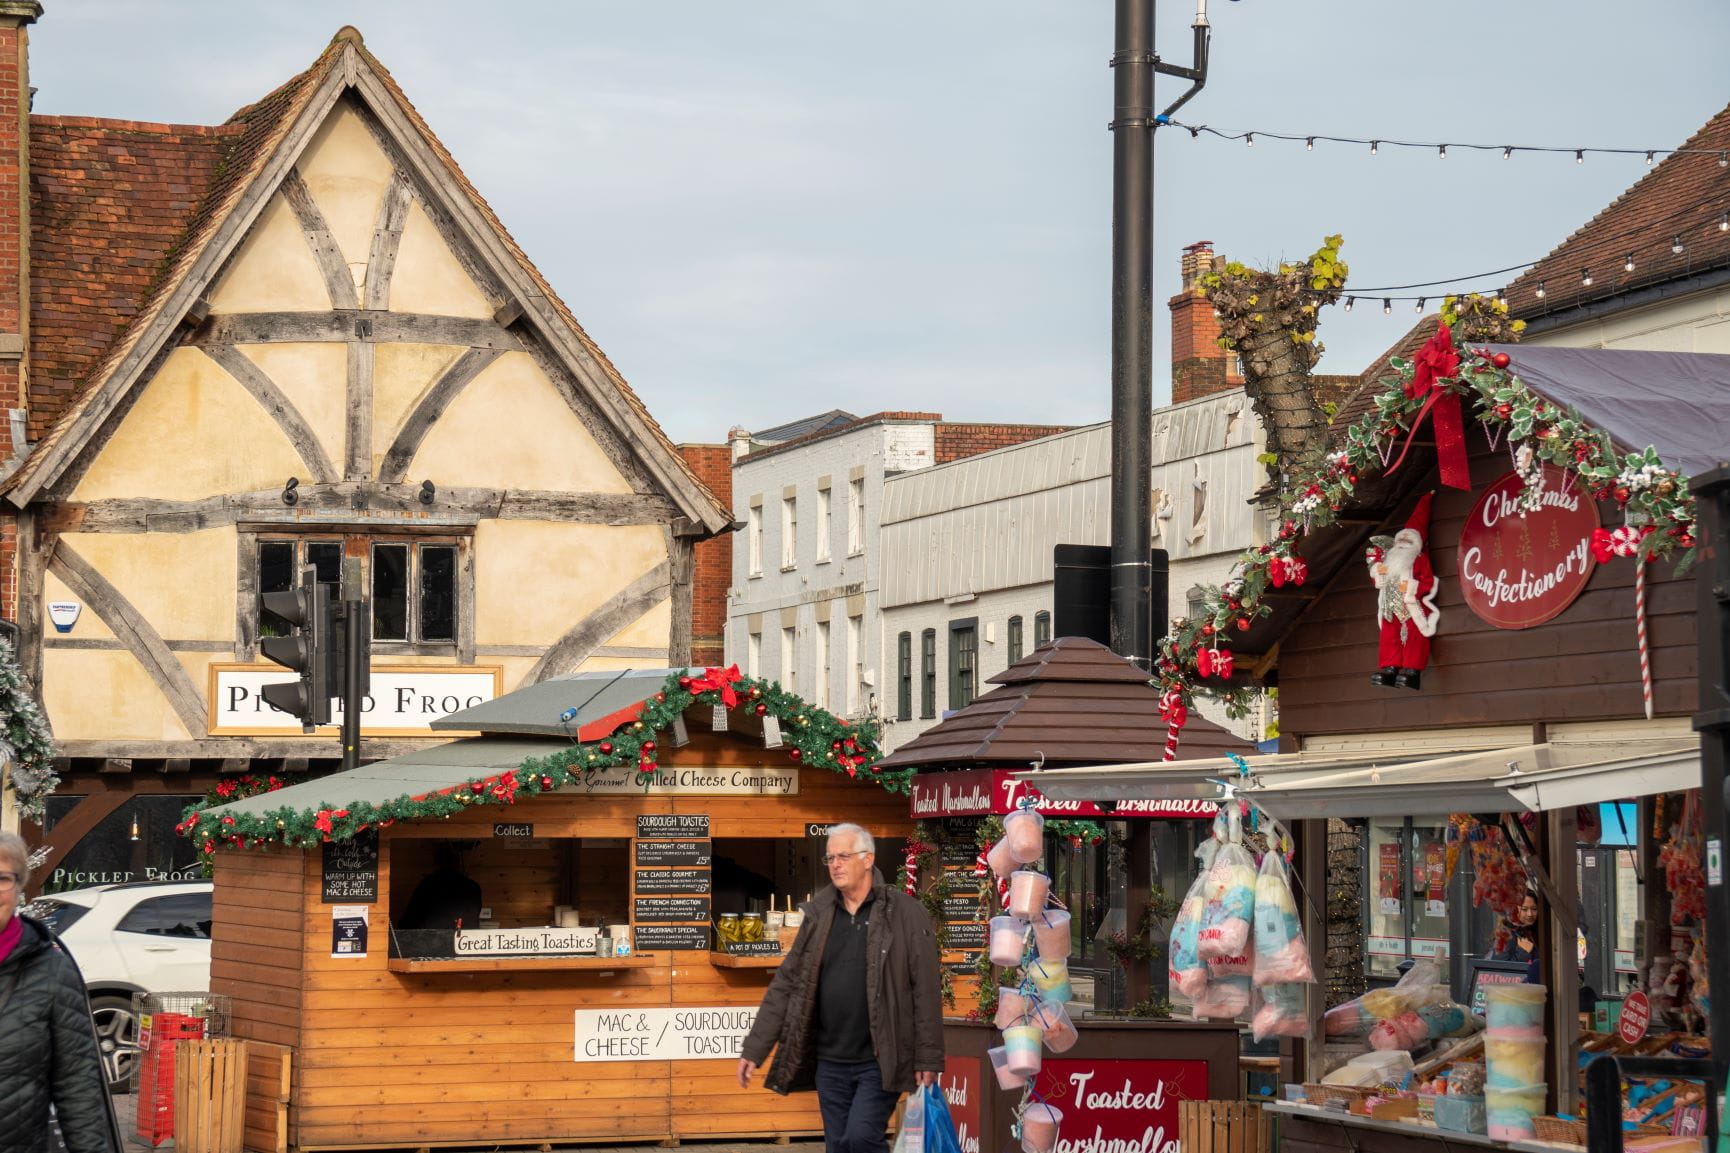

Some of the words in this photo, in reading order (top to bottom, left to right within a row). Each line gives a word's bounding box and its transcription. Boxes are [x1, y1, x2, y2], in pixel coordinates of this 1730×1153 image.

[1483, 490, 1579, 527] Chrtmas
[1463, 536, 1590, 608] Confectionery
[585, 770, 632, 793] Gourmet
[635, 771, 677, 787] Gilled
[680, 771, 727, 787] Cheese
[731, 771, 793, 793] Company
[912, 783, 938, 814] Toasted
[1002, 780, 1080, 812] Tosted
[495, 824, 530, 836] Collect
[638, 816, 677, 827] SOURDOUGH
[809, 824, 831, 836] Ord
[325, 872, 345, 881] WARM
[356, 872, 375, 881] WITH
[331, 880, 349, 889] SOME
[351, 880, 366, 888] HOT
[326, 888, 342, 896] MAC
[343, 888, 349, 896] &
[349, 888, 373, 896] CHEESE
[695, 911, 706, 920] £7
[458, 935, 492, 951] Great
[496, 935, 540, 951] Tasting
[695, 939, 706, 949] £7
[597, 1014, 632, 1033] MAC
[636, 1013, 650, 1031] &
[585, 1037, 650, 1057] CHEESE
[683, 1035, 744, 1055] TOASTIE
[1069, 1068, 1165, 1111] Toasted
